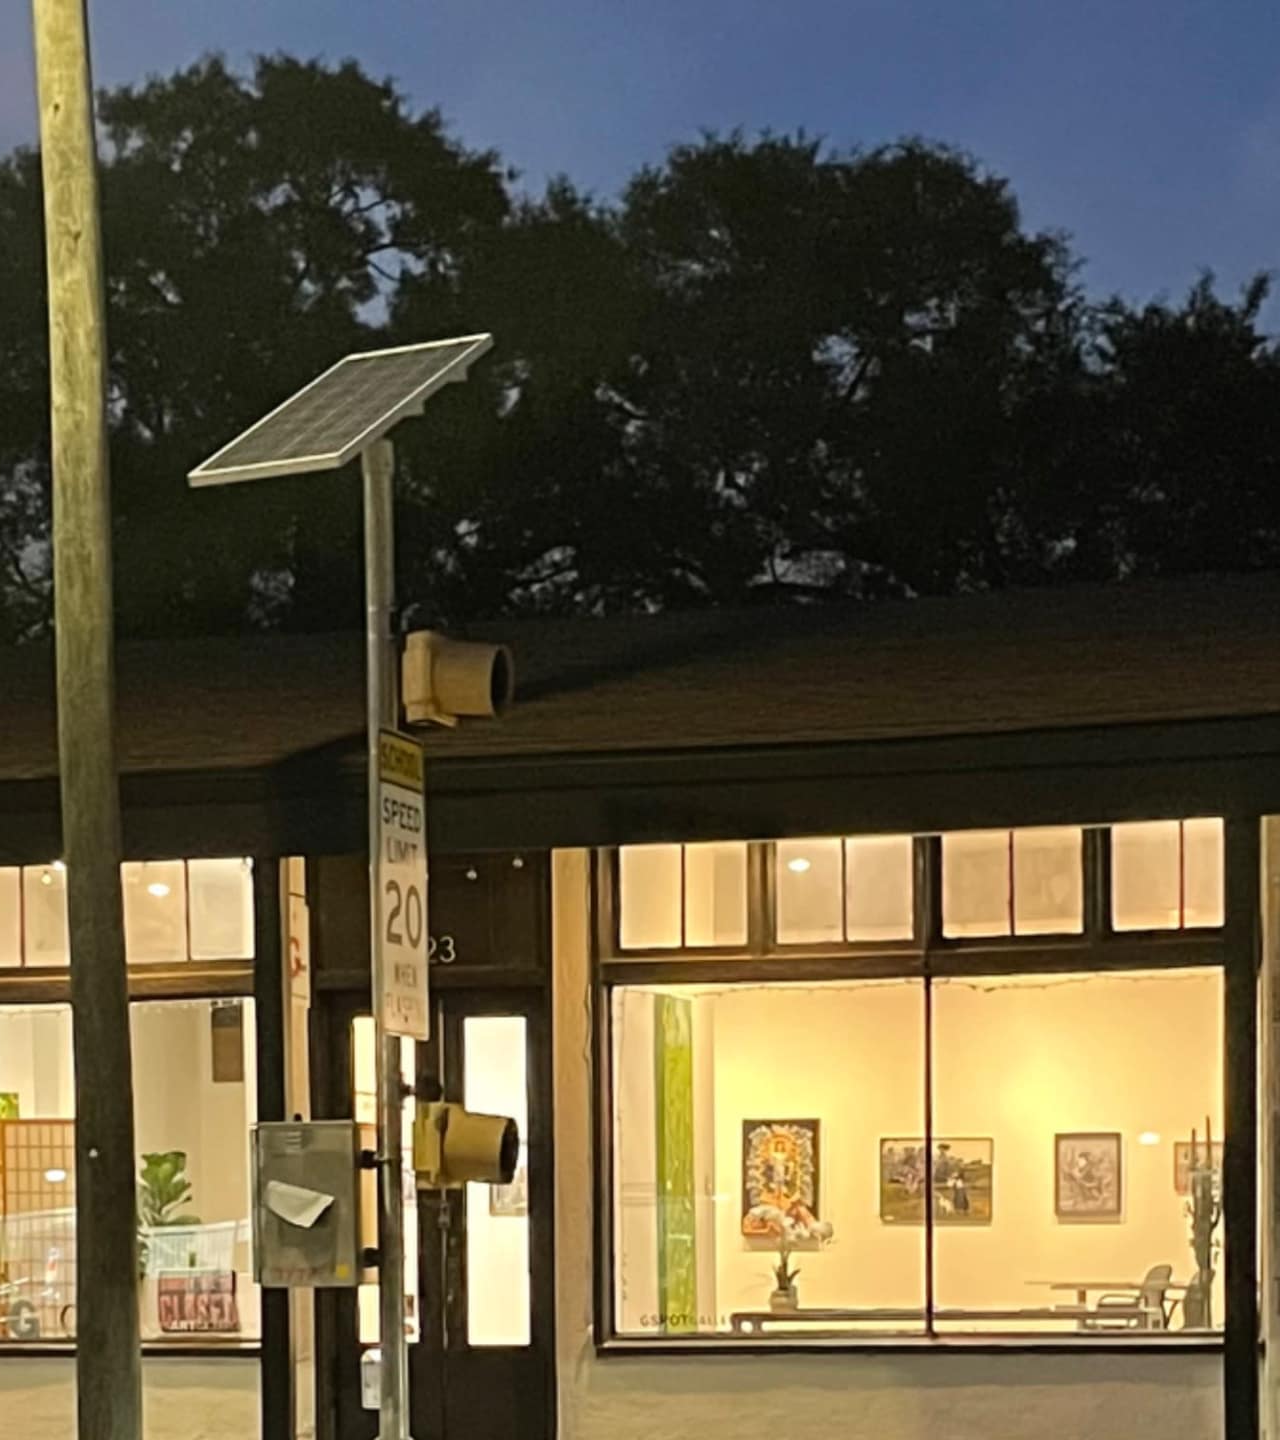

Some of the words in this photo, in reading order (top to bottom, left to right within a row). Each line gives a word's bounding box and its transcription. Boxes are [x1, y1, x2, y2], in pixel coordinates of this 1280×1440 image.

[383, 797, 420, 833] SPEED
[386, 837, 418, 863] LIMIT
[386, 879, 422, 949] 20
